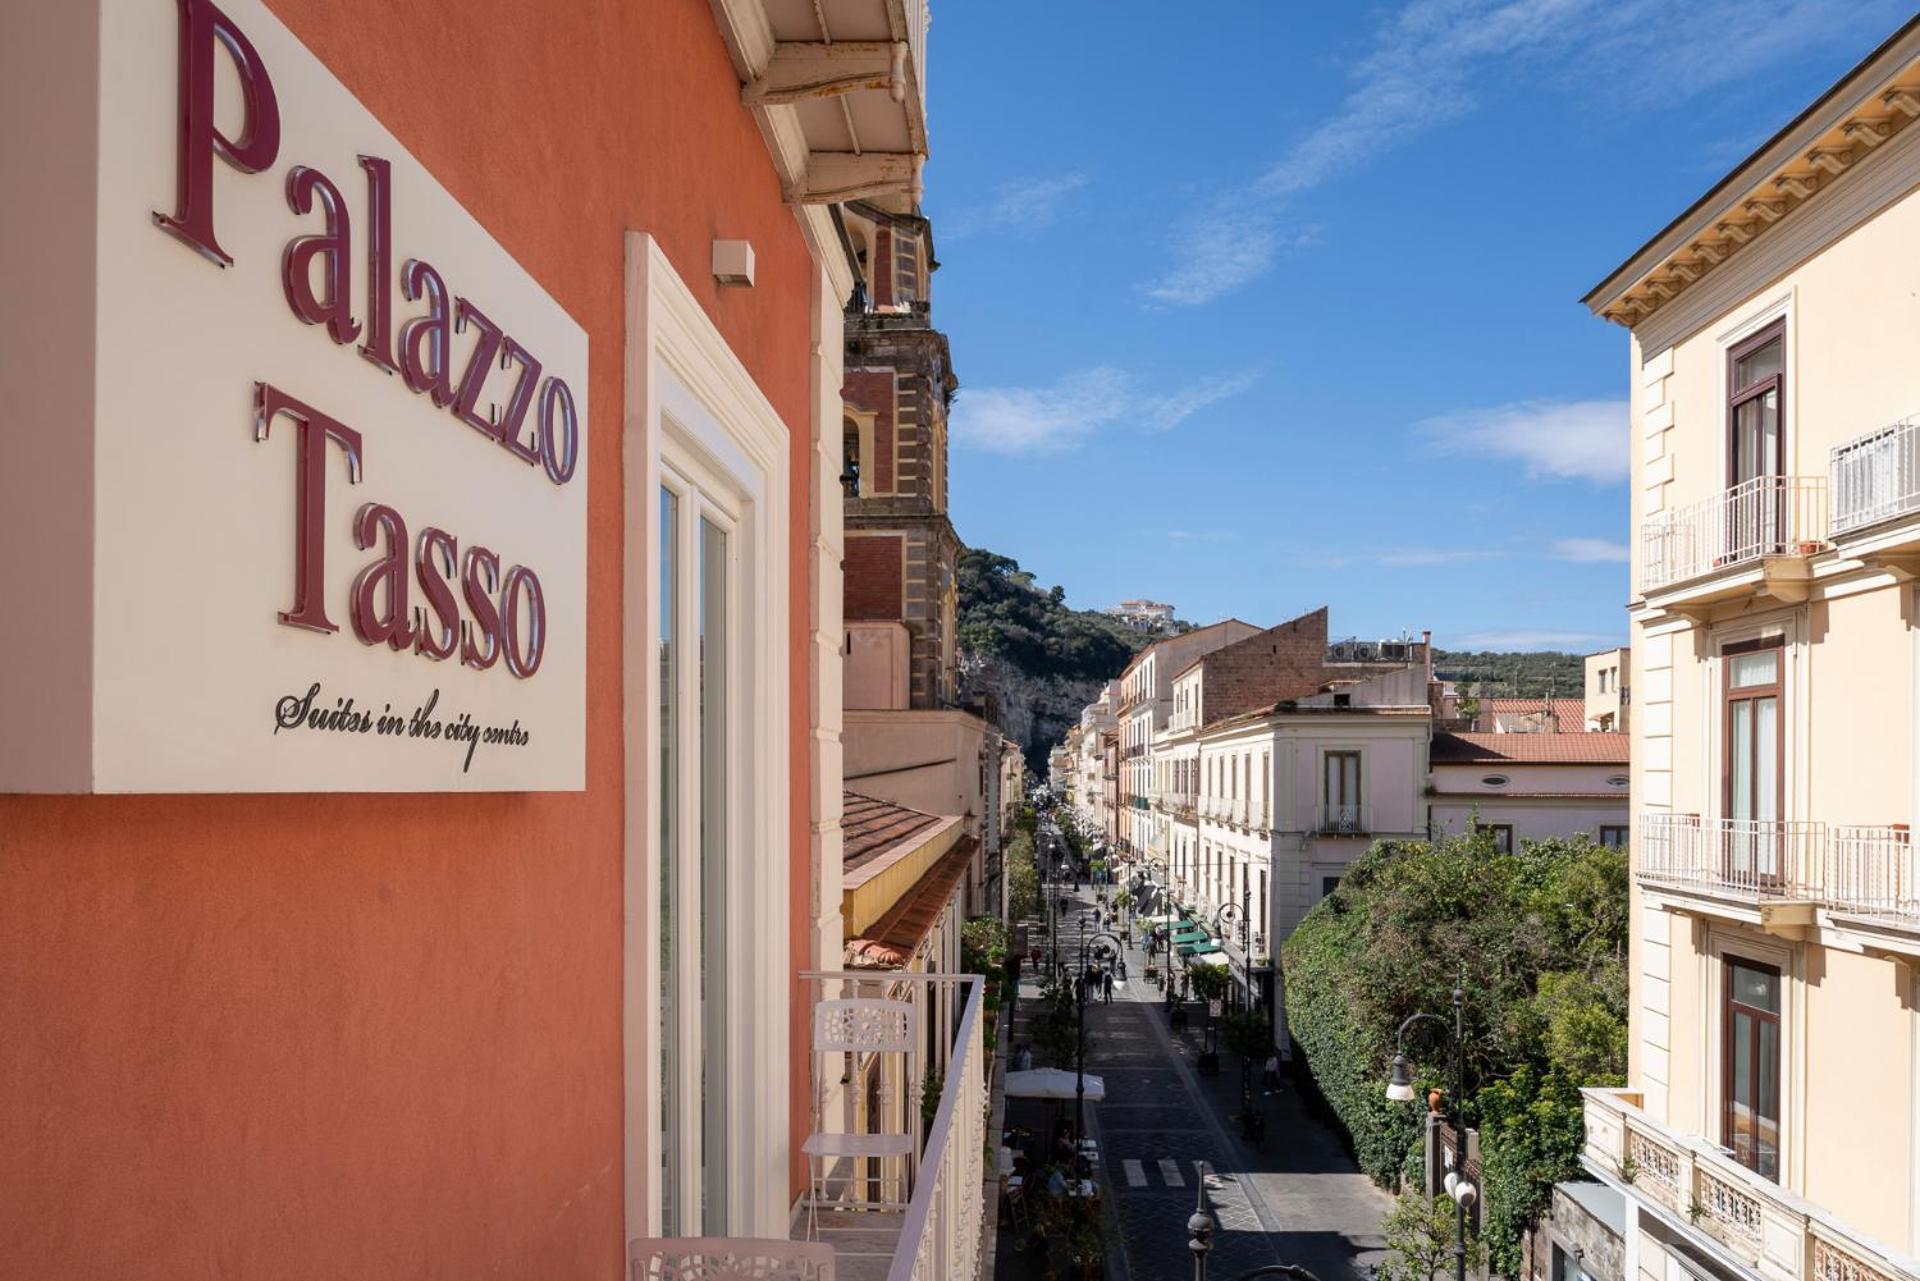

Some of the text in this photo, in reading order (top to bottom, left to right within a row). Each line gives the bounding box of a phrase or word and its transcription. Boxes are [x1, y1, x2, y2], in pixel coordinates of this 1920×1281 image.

[153, 0, 580, 485] Palazzo
[254, 379, 546, 680] Tasso
[274, 682, 373, 735] Suites
[377, 703, 406, 736] in
[409, 688, 442, 739] the
[444, 713, 480, 773] city
